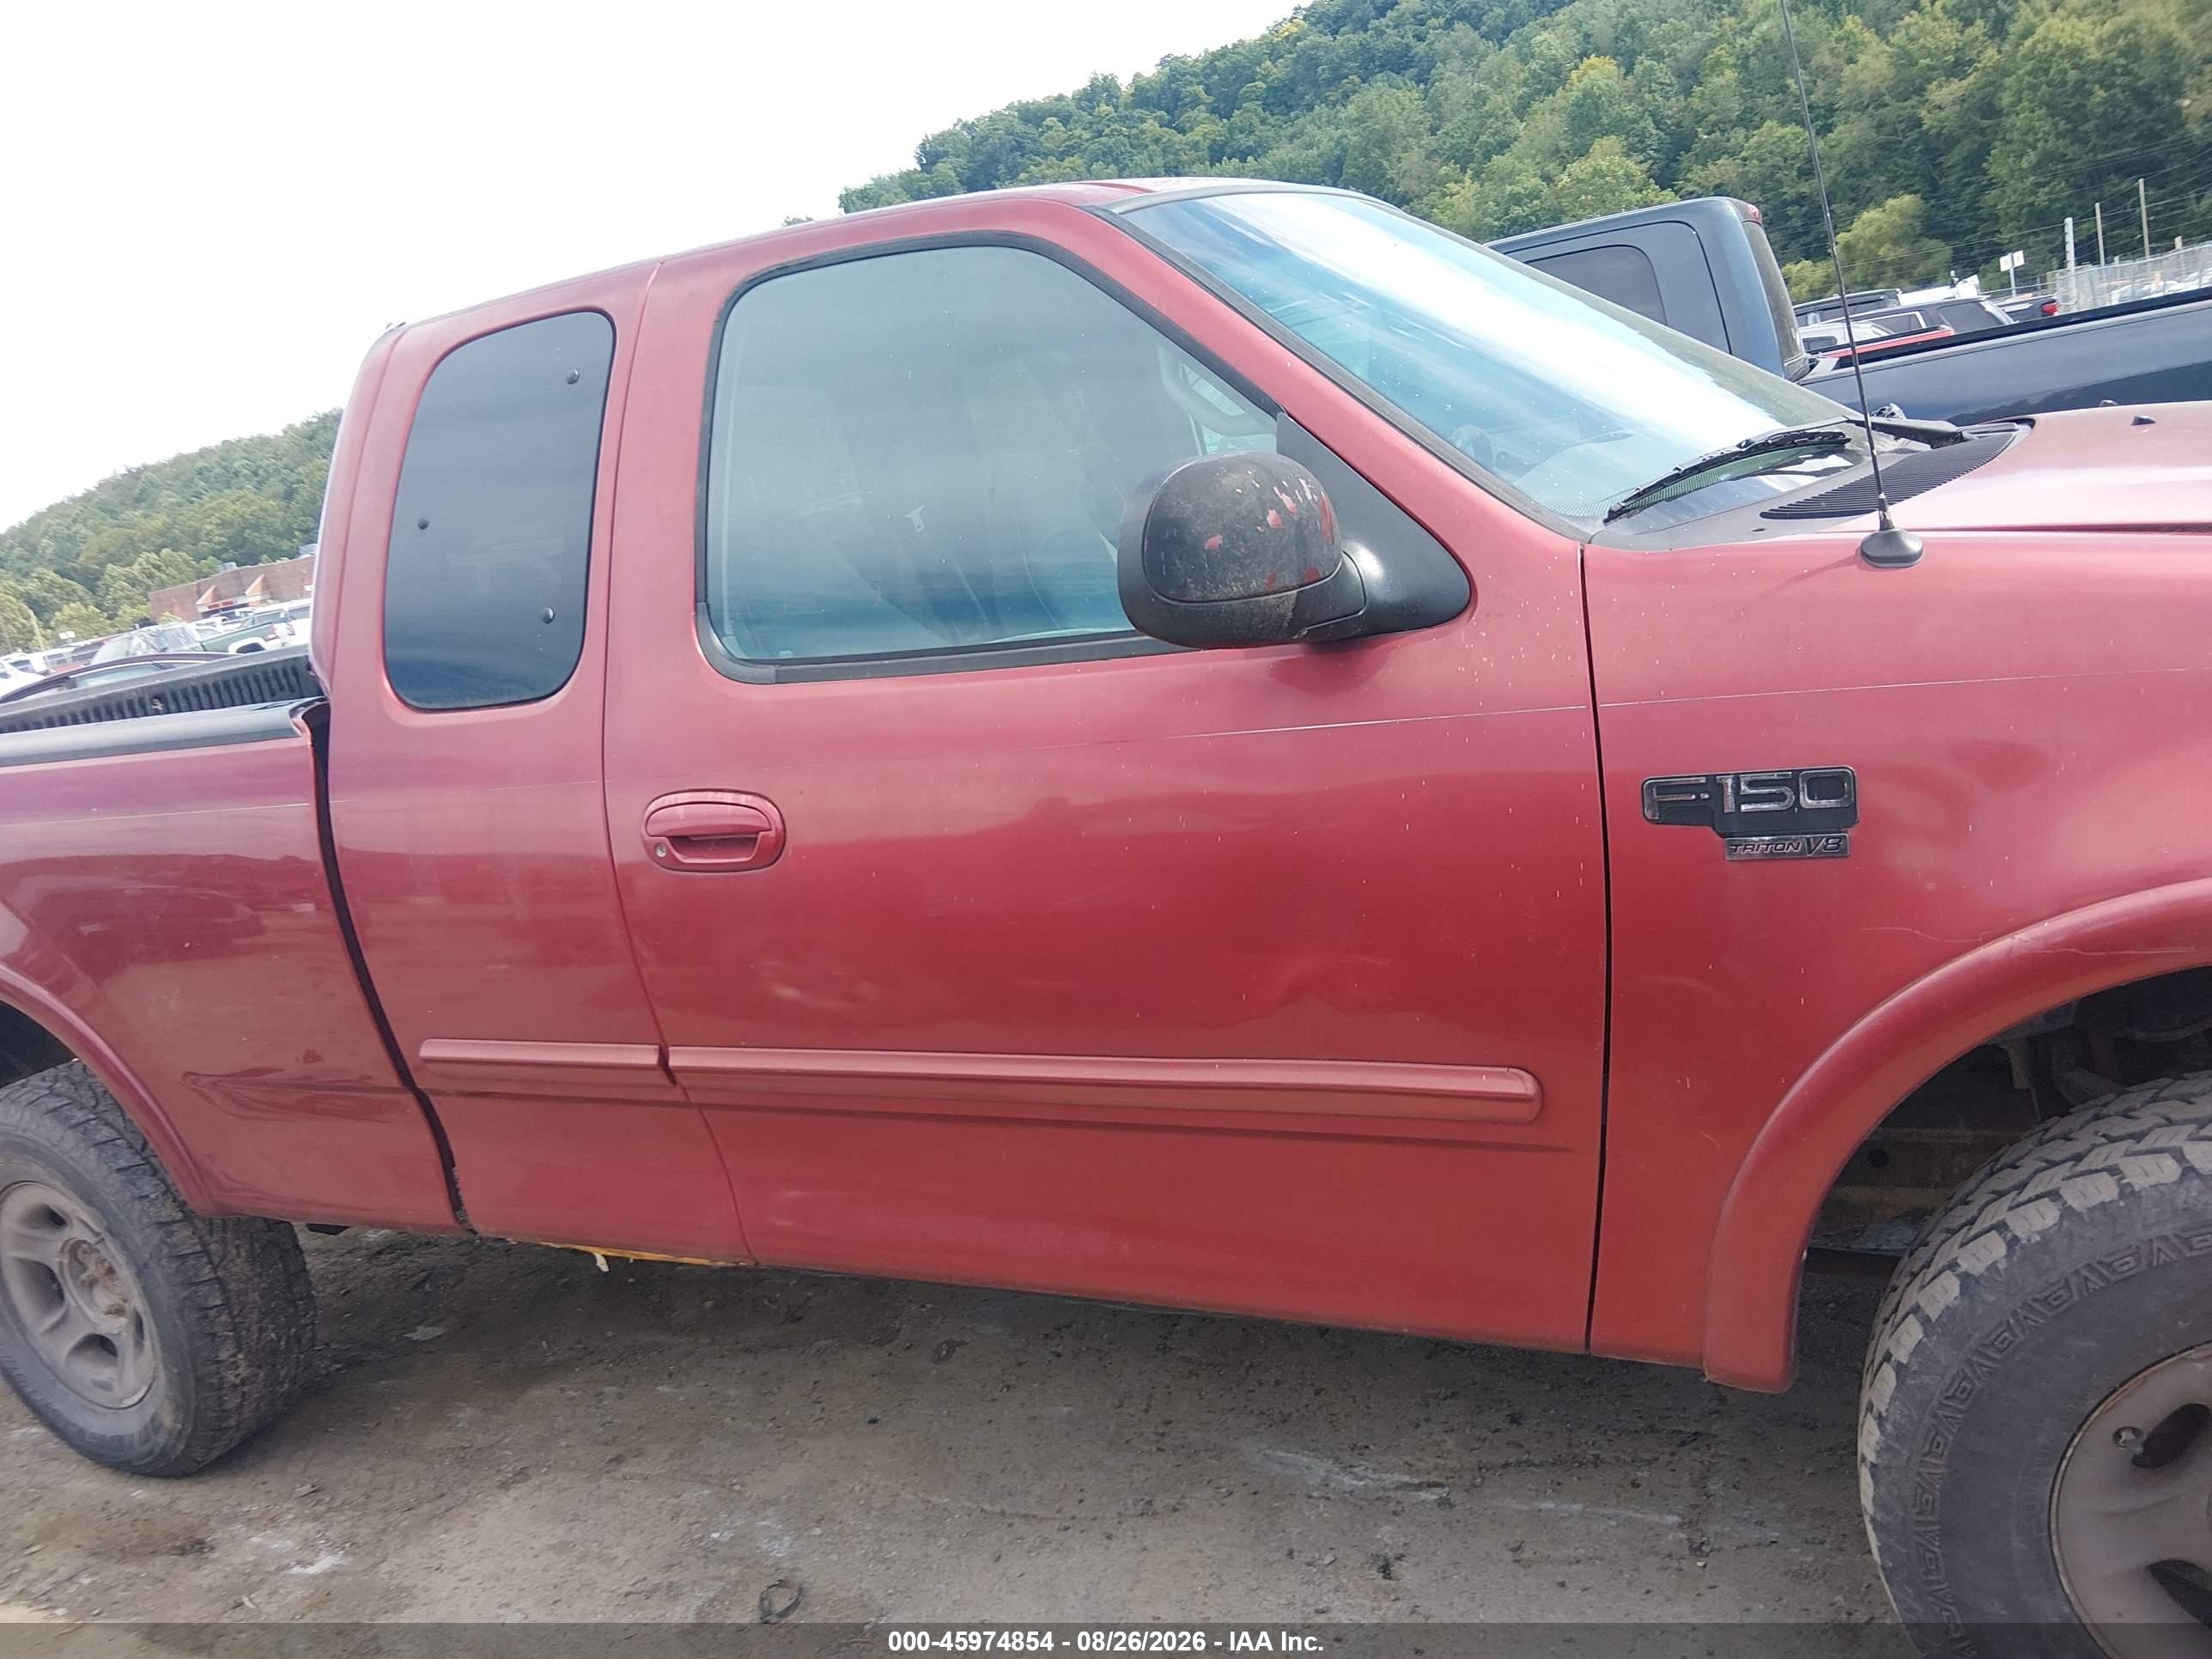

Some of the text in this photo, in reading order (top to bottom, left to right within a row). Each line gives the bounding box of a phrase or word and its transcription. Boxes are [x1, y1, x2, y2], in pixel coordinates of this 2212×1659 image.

[1643, 768, 1855, 820] F-150
[1729, 836, 1843, 857] TRITON V8
